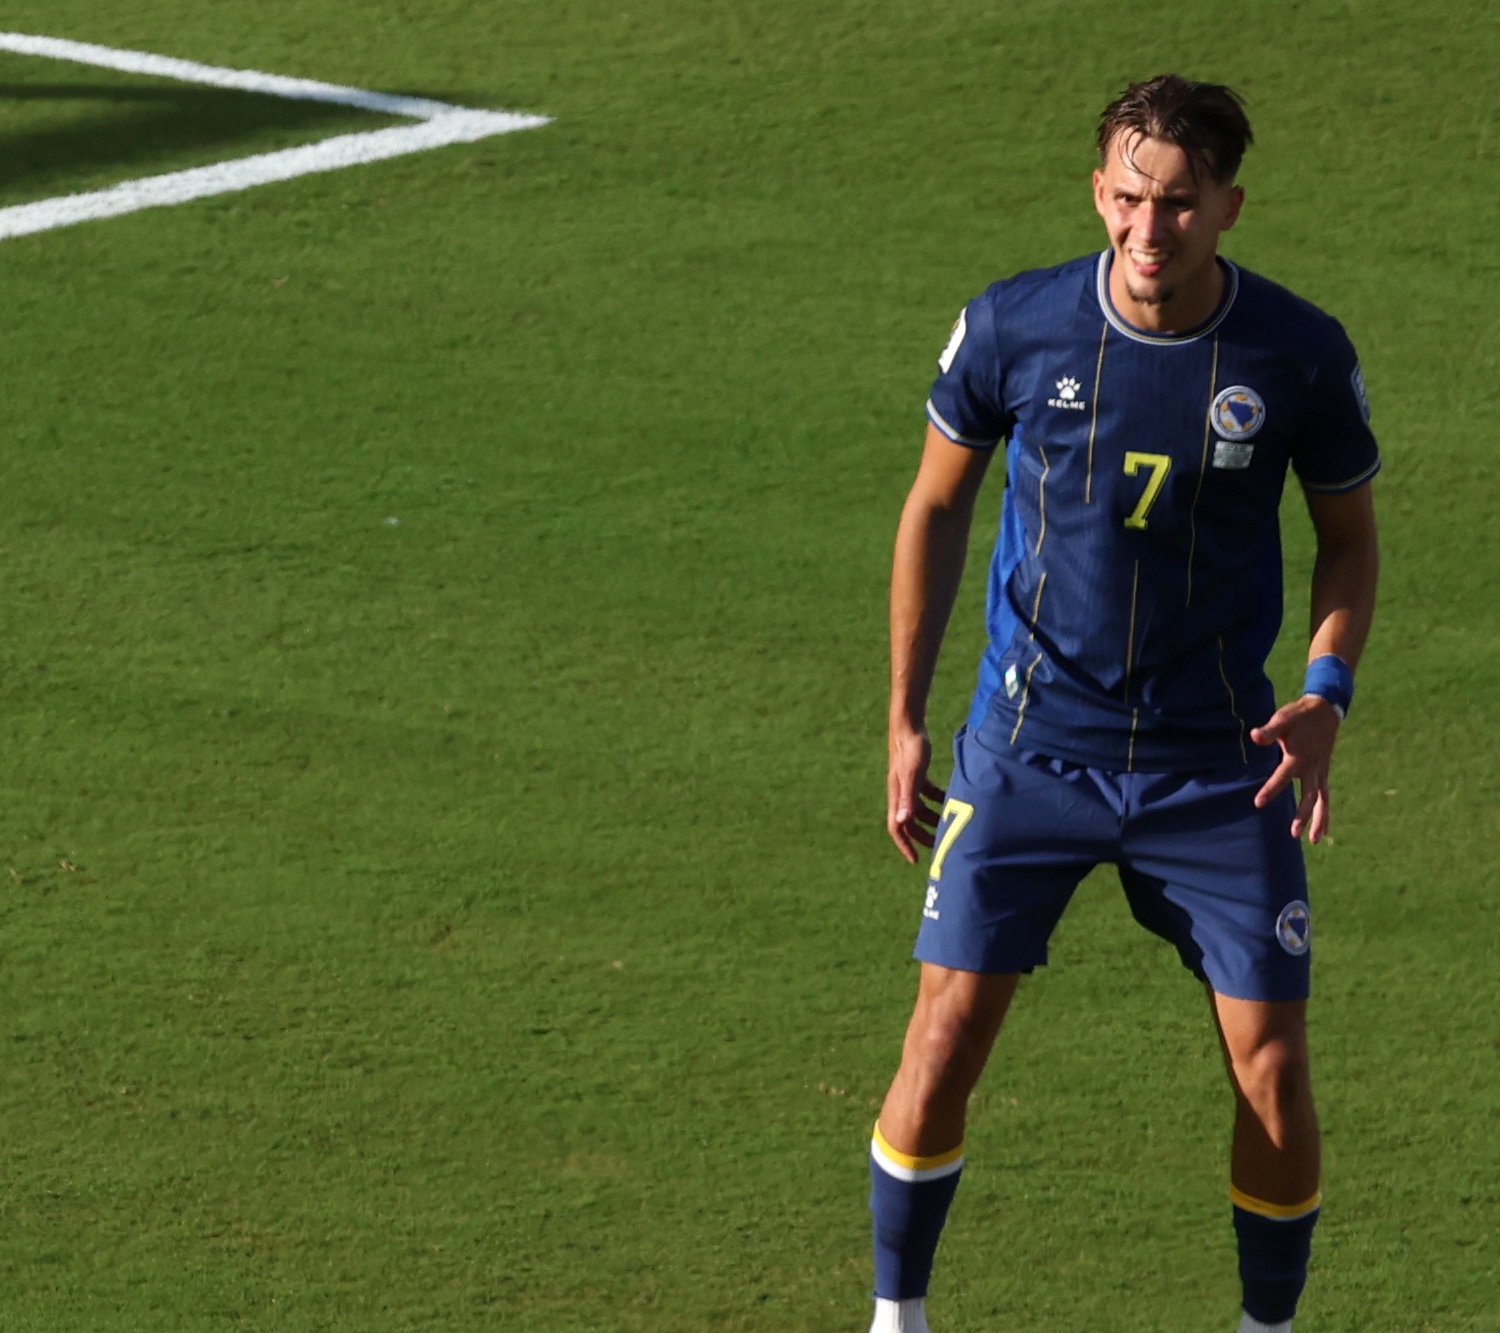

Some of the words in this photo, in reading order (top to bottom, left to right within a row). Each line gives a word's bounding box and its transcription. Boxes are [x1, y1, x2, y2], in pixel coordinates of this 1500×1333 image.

[1047, 399, 1086, 410] KELME
[1124, 451, 1172, 530] 7
[928, 797, 974, 881] 7
